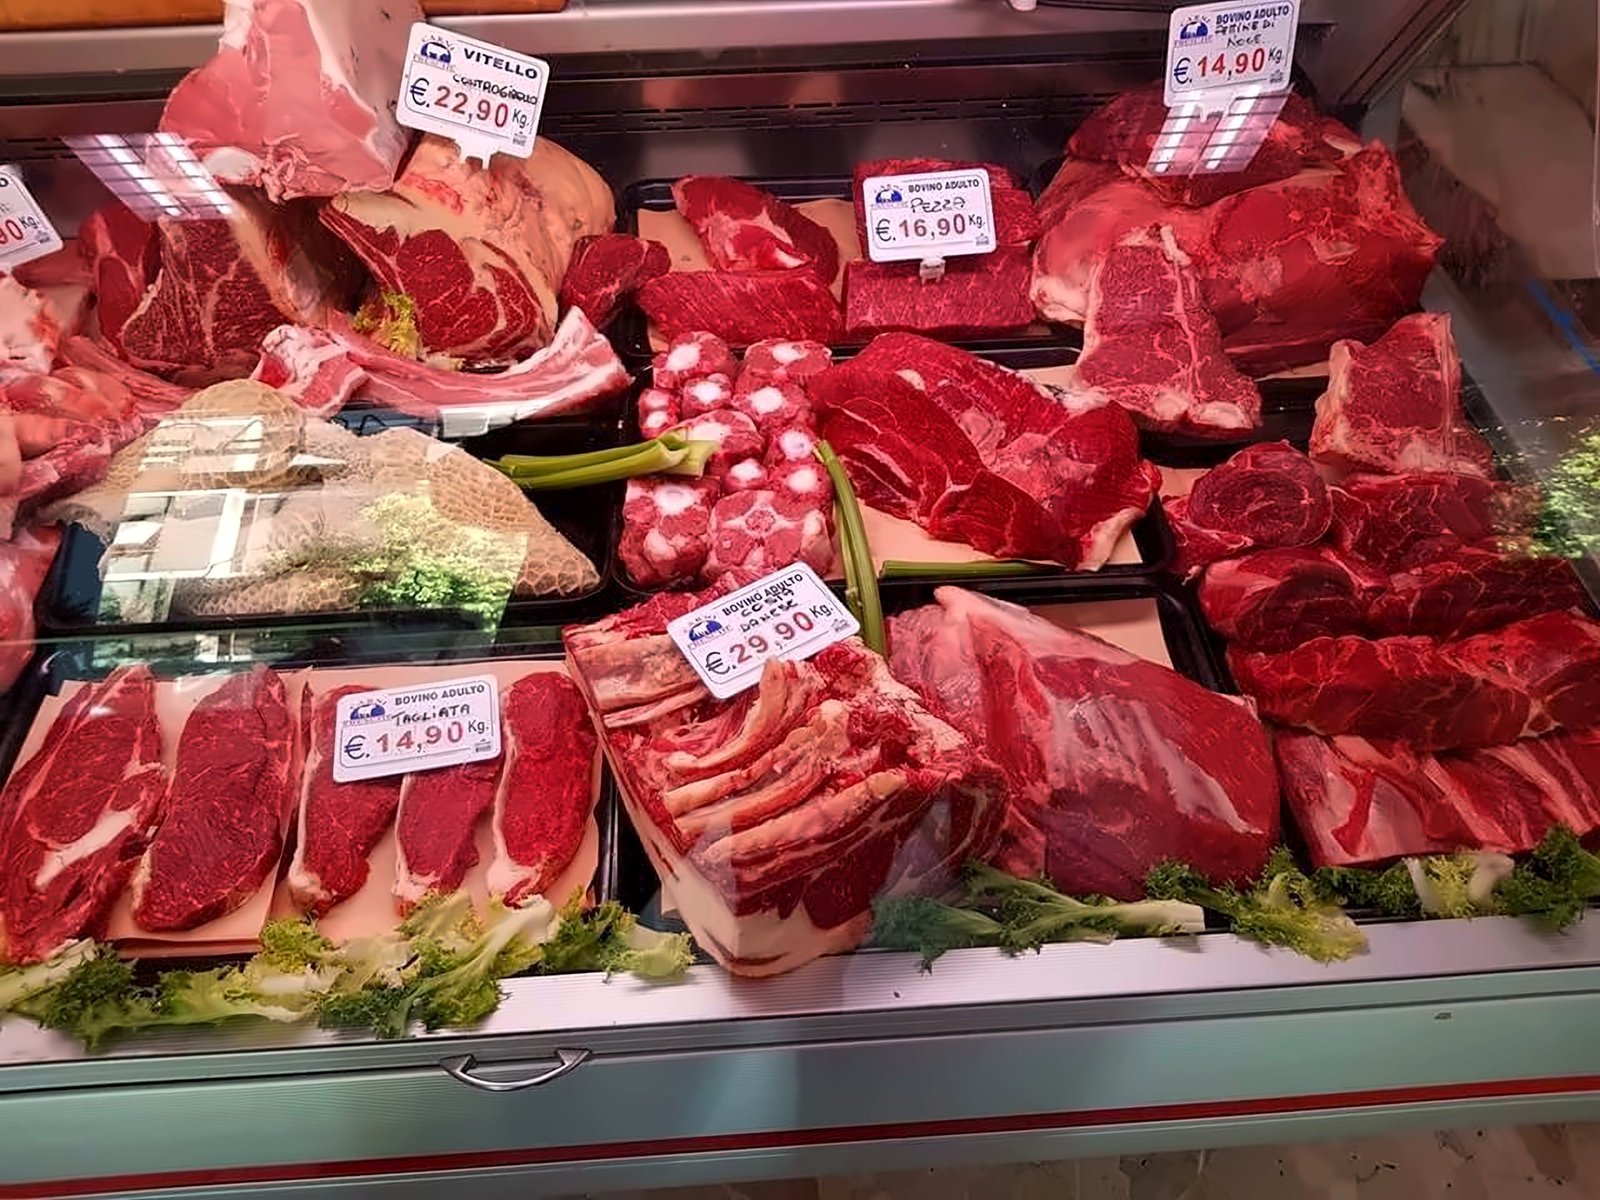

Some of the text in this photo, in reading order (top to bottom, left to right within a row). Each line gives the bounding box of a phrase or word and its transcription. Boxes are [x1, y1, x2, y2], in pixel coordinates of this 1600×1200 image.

[1215, 10, 1251, 25] BOVINO
[1253, 5, 1289, 19] ADULTO
[463, 47, 538, 79] VITELLO
[908, 183, 943, 193] BOVINO
[945, 179, 980, 190] ADULTO
[722, 573, 804, 616] BOVINO ADULTO
[395, 691, 439, 706] BOVINO
[441, 684, 485, 699] ADULTO
